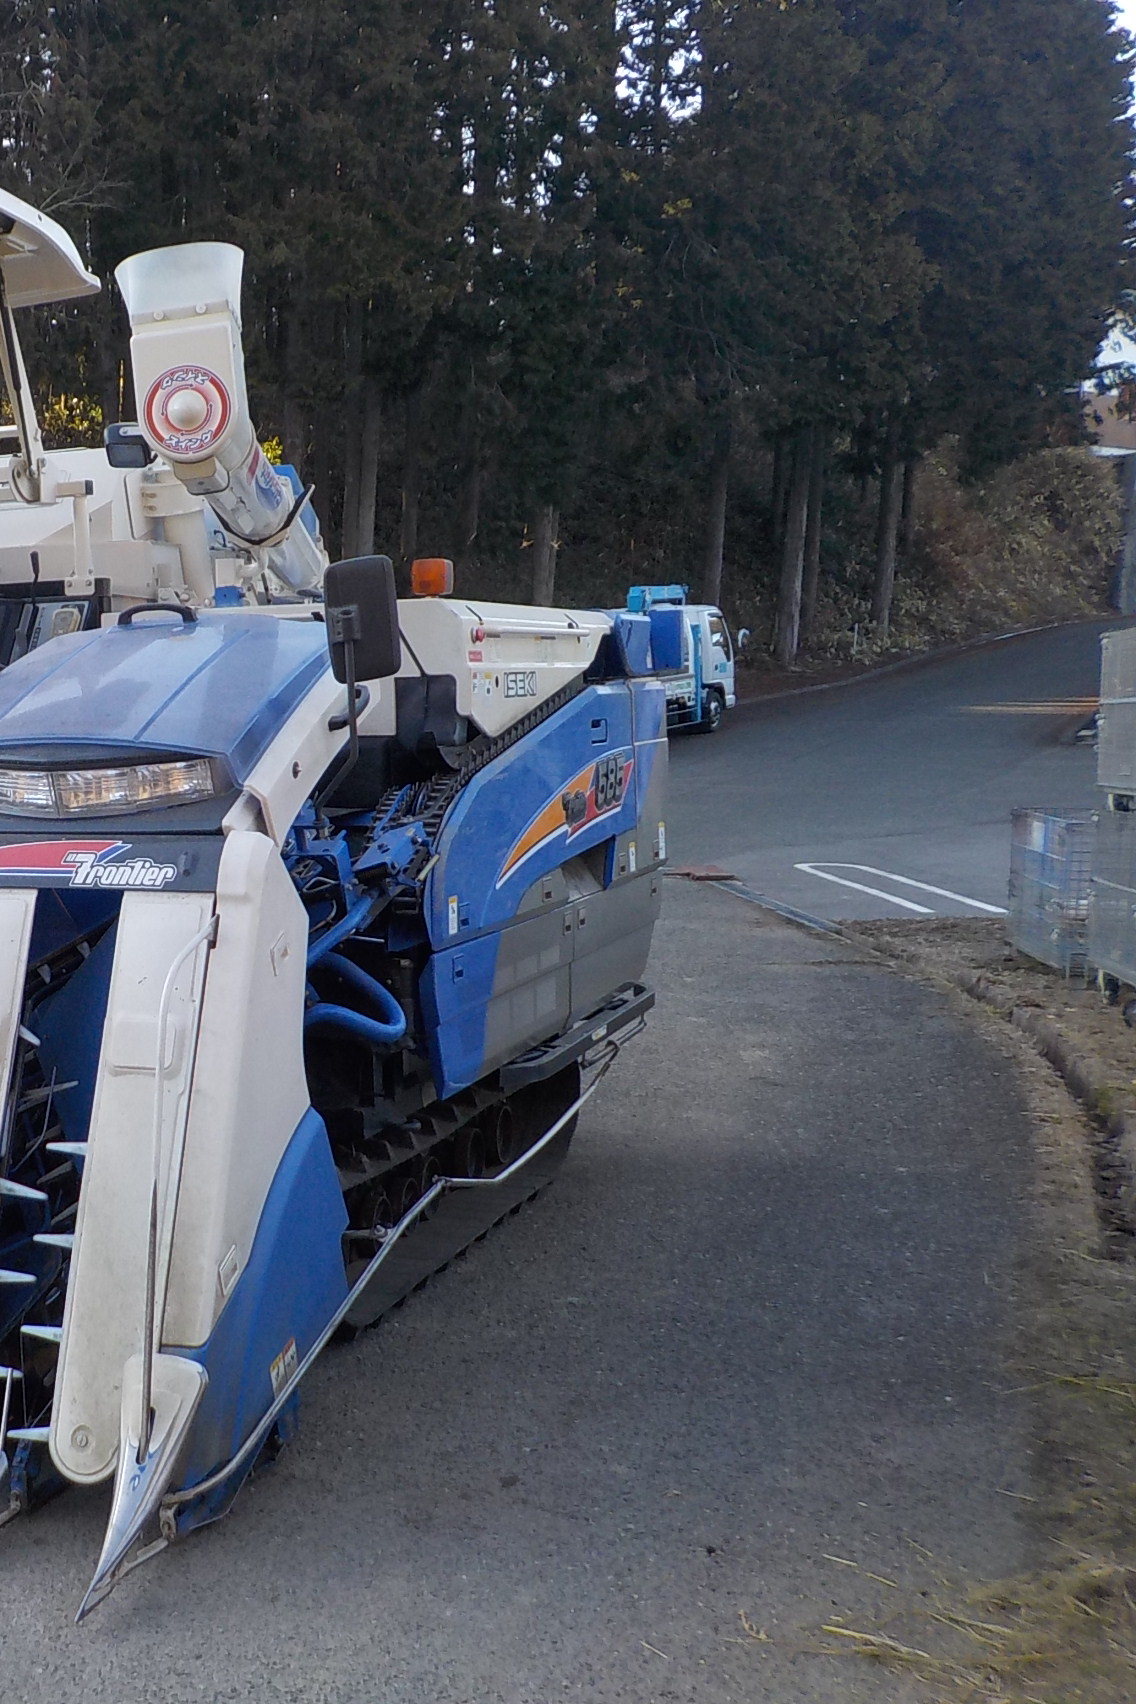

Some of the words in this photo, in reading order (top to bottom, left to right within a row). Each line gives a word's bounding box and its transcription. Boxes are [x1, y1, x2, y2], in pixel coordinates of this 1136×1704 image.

[165, 430, 213, 449] スイング
[504, 671, 537, 698] ISEKI
[64, 852, 176, 887] Frontier
